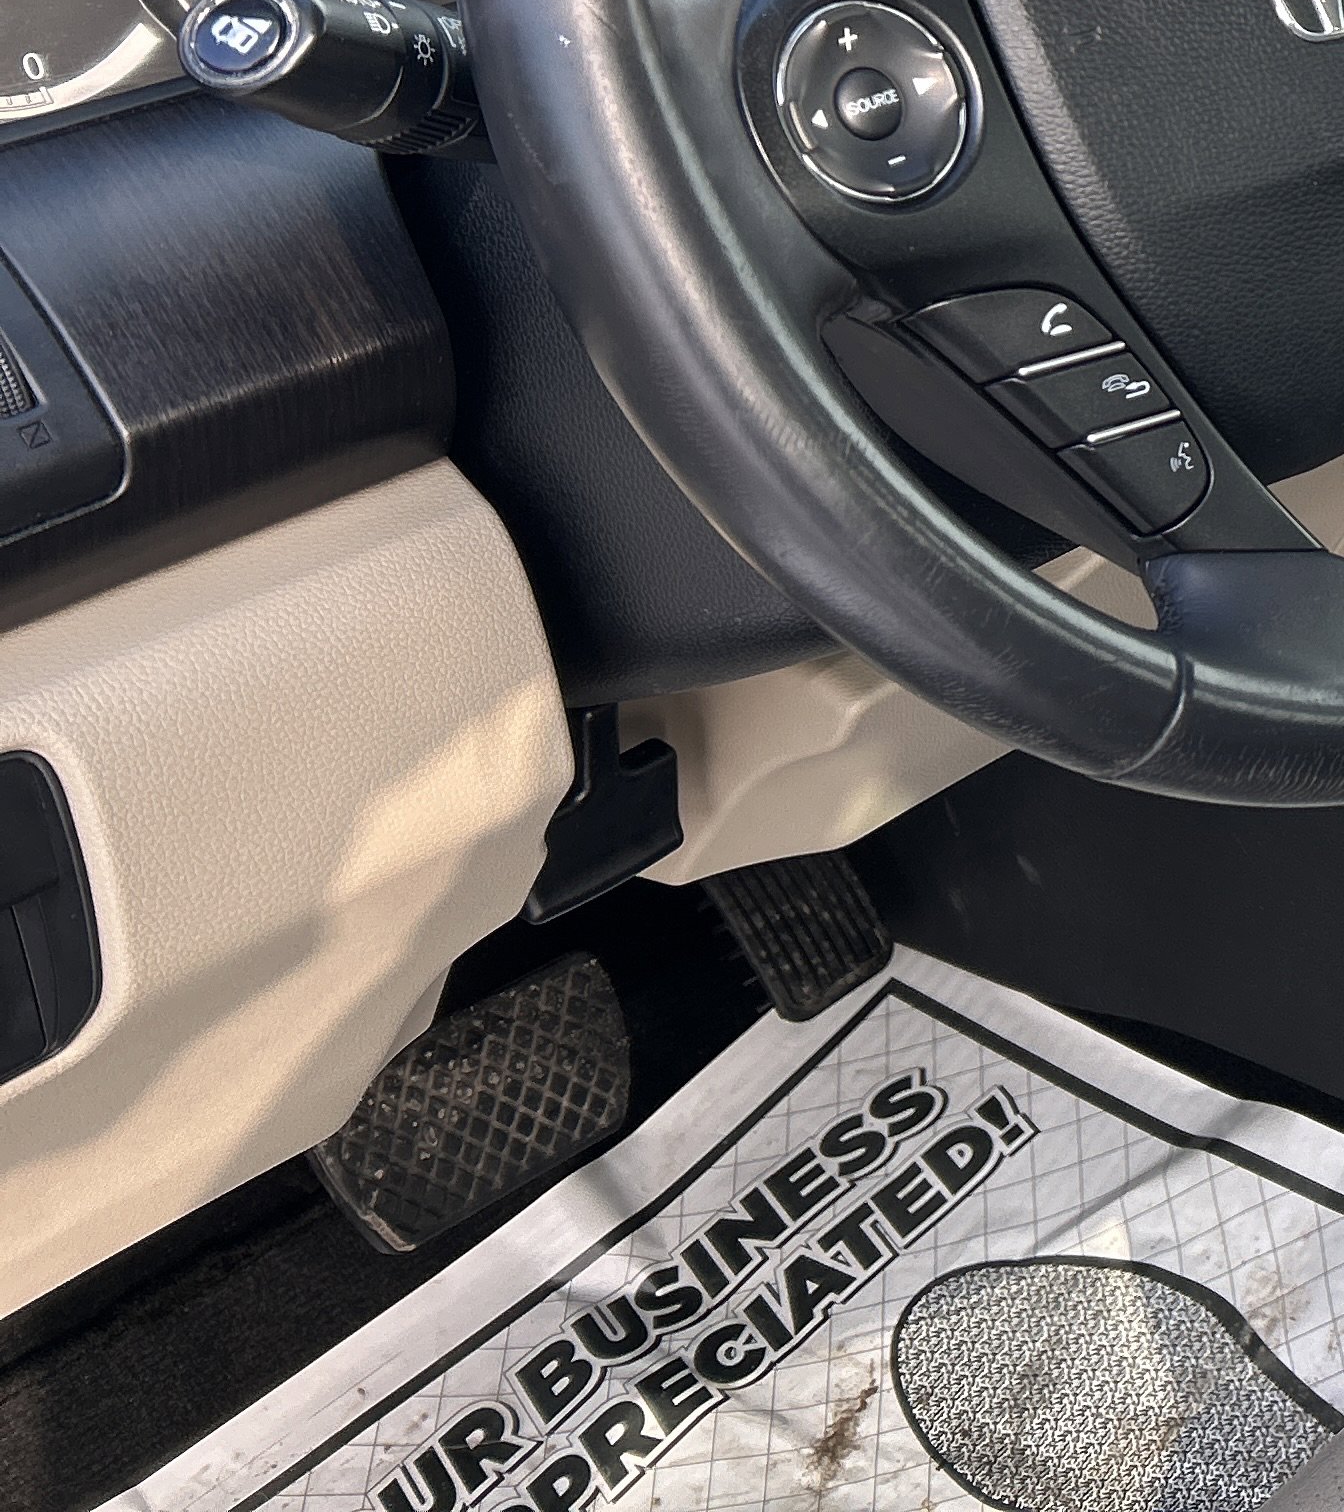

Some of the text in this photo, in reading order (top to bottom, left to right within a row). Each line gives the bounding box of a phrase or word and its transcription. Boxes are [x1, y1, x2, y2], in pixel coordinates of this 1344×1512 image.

[21, 53, 44, 81] 0
[843, 88, 900, 119] SOURCE
[498, 1091, 1028, 1512] PRECIATED!
[514, 1067, 943, 1426] BUSINESS
